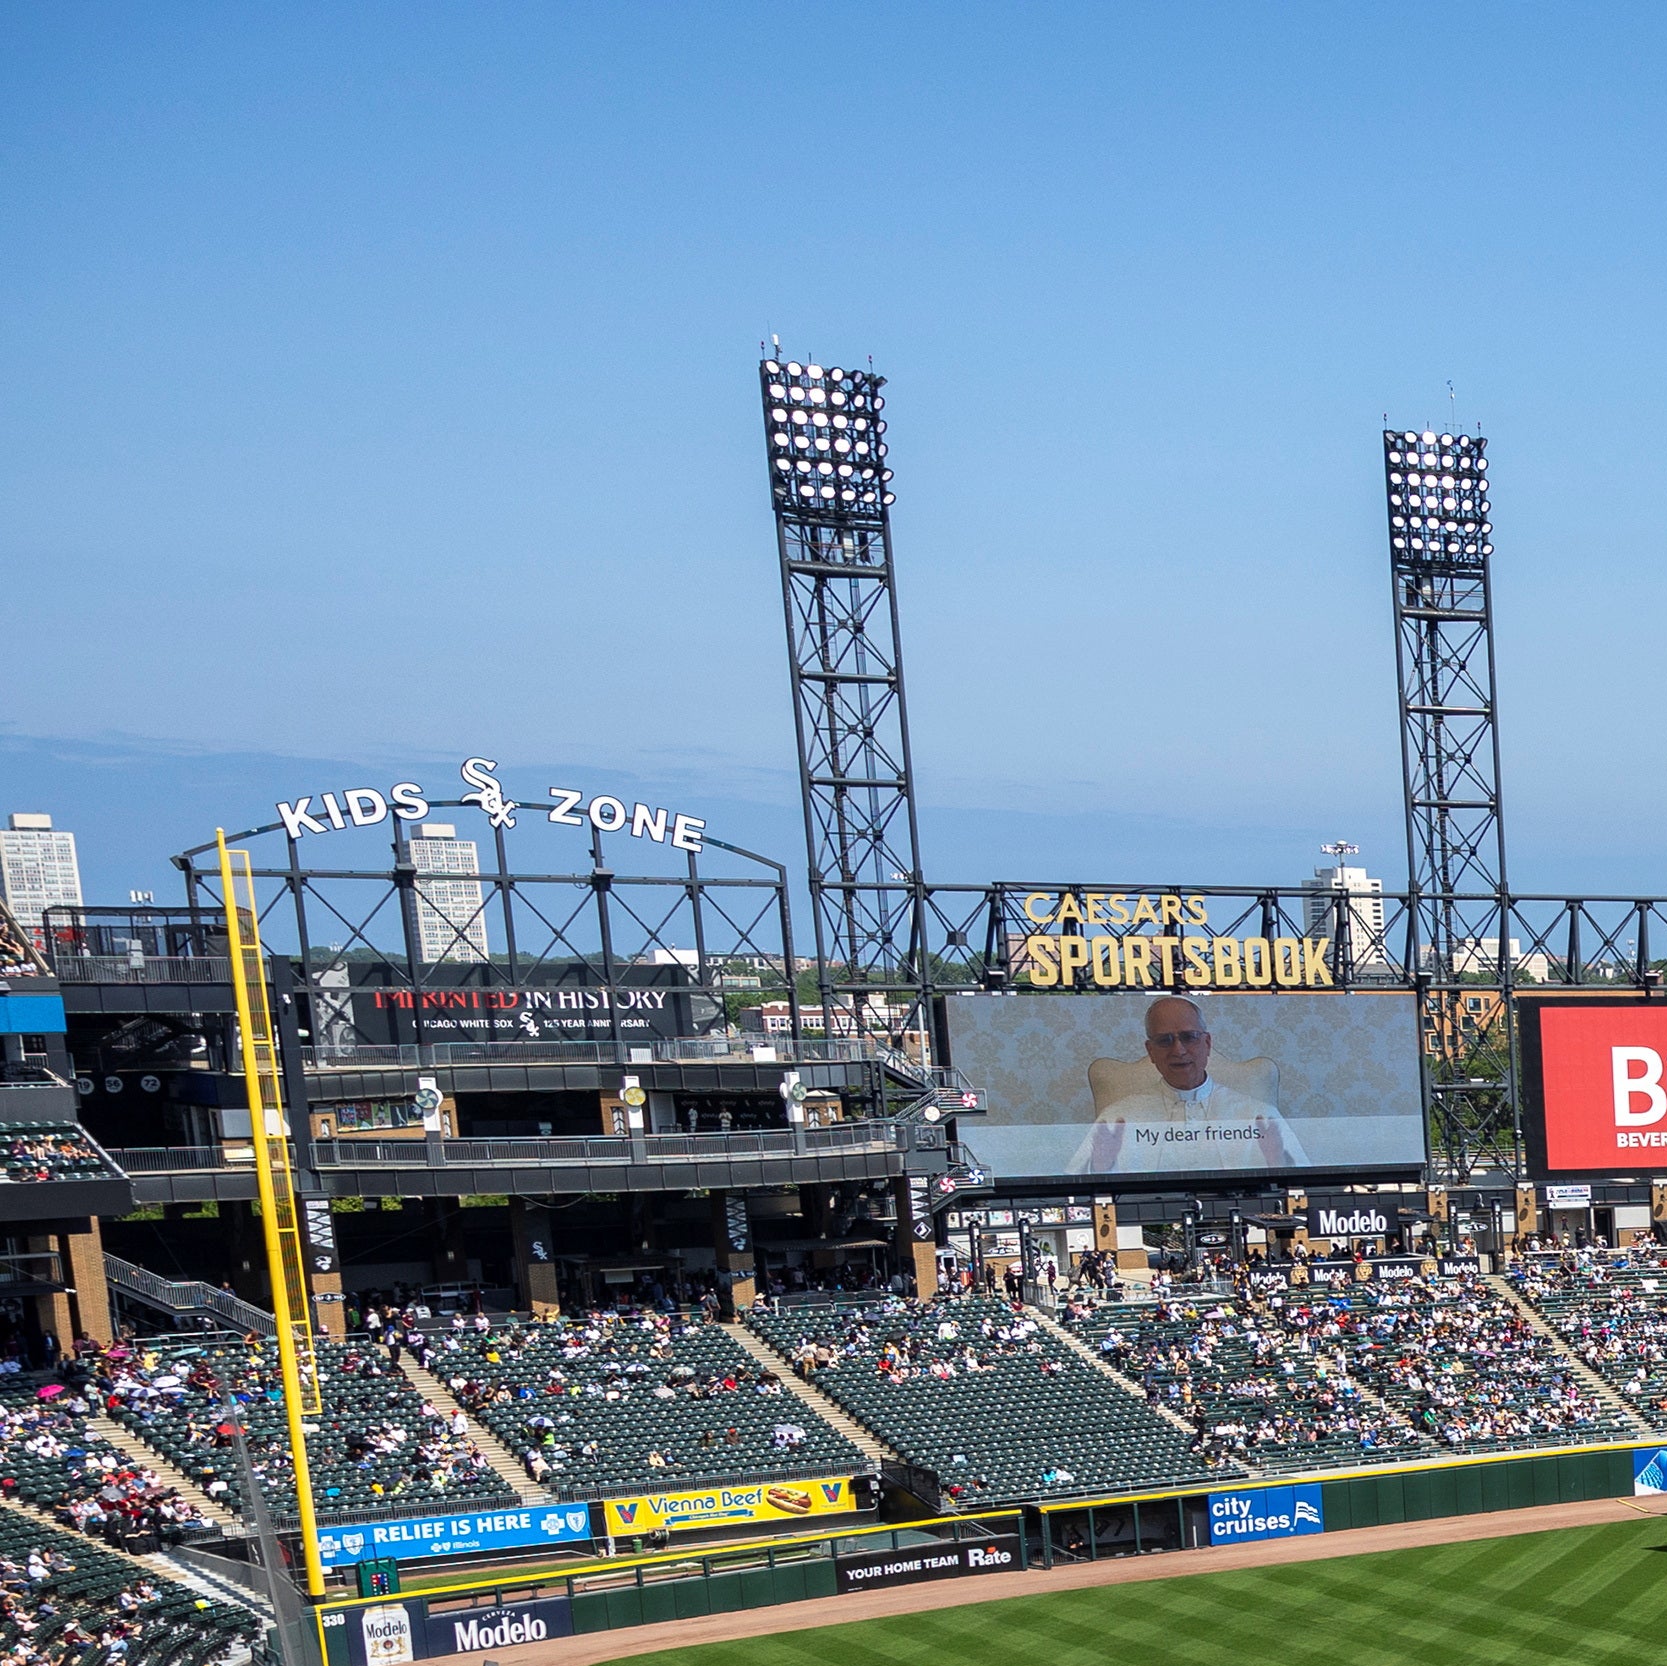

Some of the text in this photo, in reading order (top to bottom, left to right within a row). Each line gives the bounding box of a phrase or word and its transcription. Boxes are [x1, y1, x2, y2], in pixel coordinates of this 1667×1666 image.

[276, 782, 429, 839] KIDS
[548, 787, 706, 853] ZONE
[1024, 894, 1208, 925] CAESARS
[1028, 935, 1333, 986] SPORTSBOOK
[526, 991, 551, 1009] IN
[460, 1019, 585, 1028] WHITE SOX 125 YEAR
[105, 1078, 121, 1091] 56
[143, 1078, 158, 1090] 72
[1135, 1122, 1265, 1147] My dear friends.
[1319, 1209, 1387, 1234] Modelo
[1379, 1265, 1413, 1279] Modelo
[1444, 1262, 1478, 1275] Modelo
[648, 1488, 763, 1515] Vienna Beef
[1212, 1498, 1251, 1520] city
[374, 1513, 531, 1543] RELIEF IS HERE
[1213, 1513, 1291, 1537] cruises
[847, 1555, 959, 1580] YOUR HOME TEAM
[968, 1548, 1012, 1567] Rate
[322, 1613, 346, 1627] 330
[482, 1610, 516, 1621] CERVEZA
[366, 1621, 408, 1639] Modelo
[454, 1613, 547, 1652] Modelo
